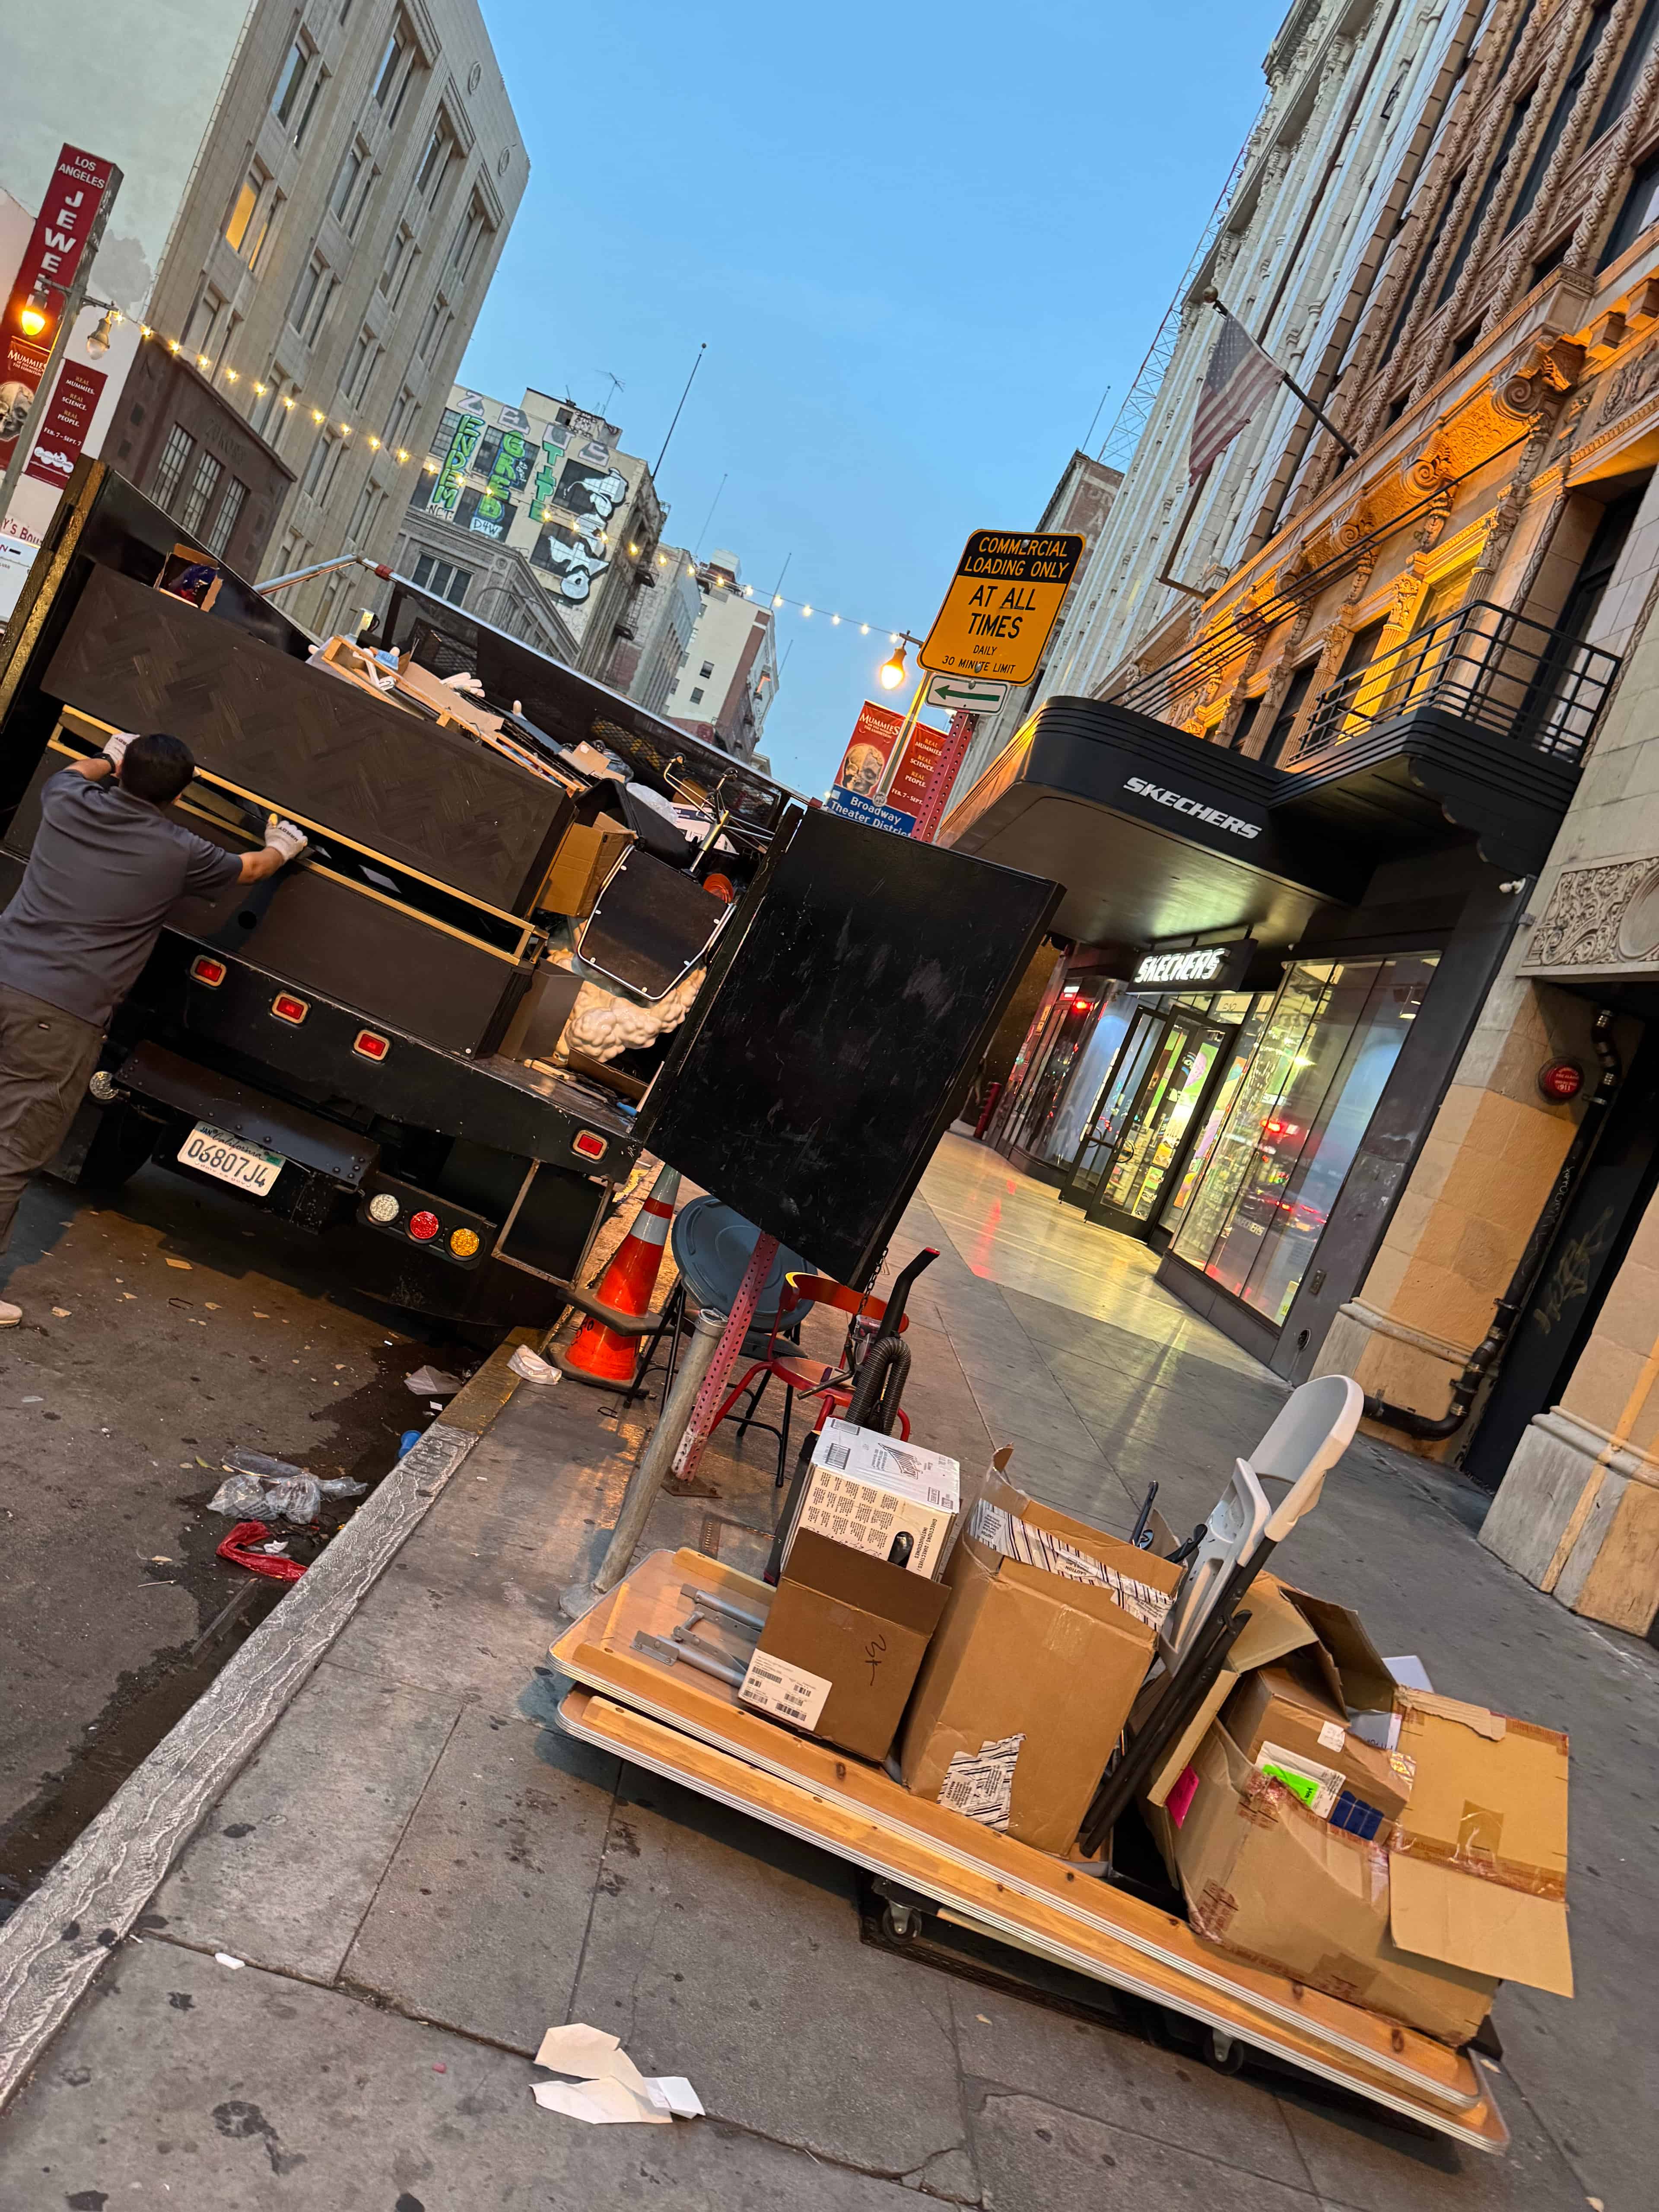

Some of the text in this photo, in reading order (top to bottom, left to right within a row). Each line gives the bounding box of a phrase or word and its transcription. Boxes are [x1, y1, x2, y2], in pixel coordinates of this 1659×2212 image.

[75, 156, 96, 171] LOS
[58, 163, 105, 189] ANGELES
[979, 537, 1068, 557] COMMERCIAL
[964, 556, 1070, 578] LOADING ONLY
[968, 585, 1036, 611] AT ALL
[968, 613, 1023, 639] TIMES
[973, 645, 998, 655] DAILY
[942, 655, 1017, 674] 30 MINUTE LIMIT
[859, 713, 900, 736] MUMMIES
[925, 738, 938, 747] REAL
[909, 758, 934, 772] SCIENCE.
[918, 754, 931, 764] REAL
[905, 775, 927, 788] PEOPLE.
[911, 771, 925, 780] REAL
[891, 788, 903, 798] FEB.
[909, 796, 923, 805] SEPT.
[1123, 777, 1262, 839] SKECHERS
[830, 800, 871, 823] Theater
[850, 796, 902, 825] Broadway
[1134, 947, 1228, 983] SKECHERS
[200, 1127, 212, 1136] JAN
[212, 1132, 262, 1158] California
[188, 1139, 268, 1188] 06807J4
[928, 1518, 938, 1543] DIRECTIONS
[914, 1527, 929, 1559] INSTRUCCIONES
[918, 1545, 930, 1569] DIRECTIVES
